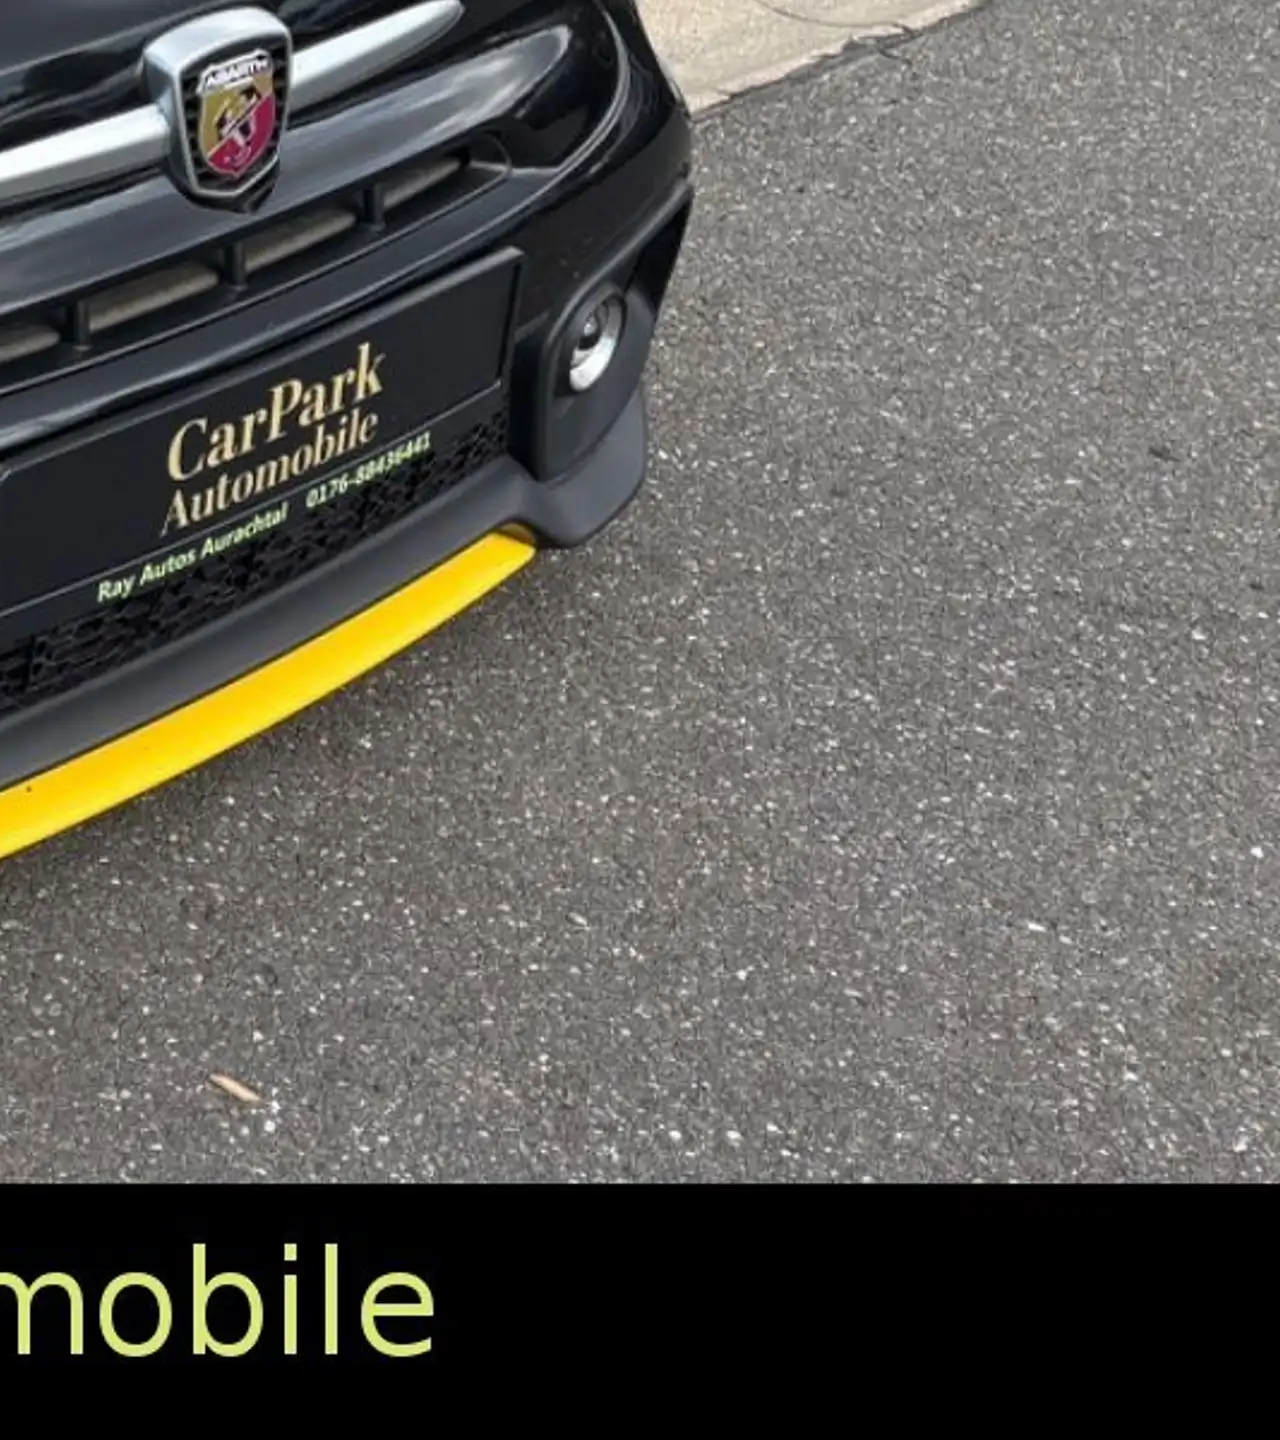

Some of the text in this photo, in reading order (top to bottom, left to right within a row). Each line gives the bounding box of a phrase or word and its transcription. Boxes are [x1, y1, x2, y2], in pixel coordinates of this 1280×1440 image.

[159, 408, 379, 538] Automobile
[167, 341, 387, 482] CarPark
[97, 574, 136, 602] Ray
[140, 546, 197, 585] Autos
[200, 501, 289, 558] Aurachtal
